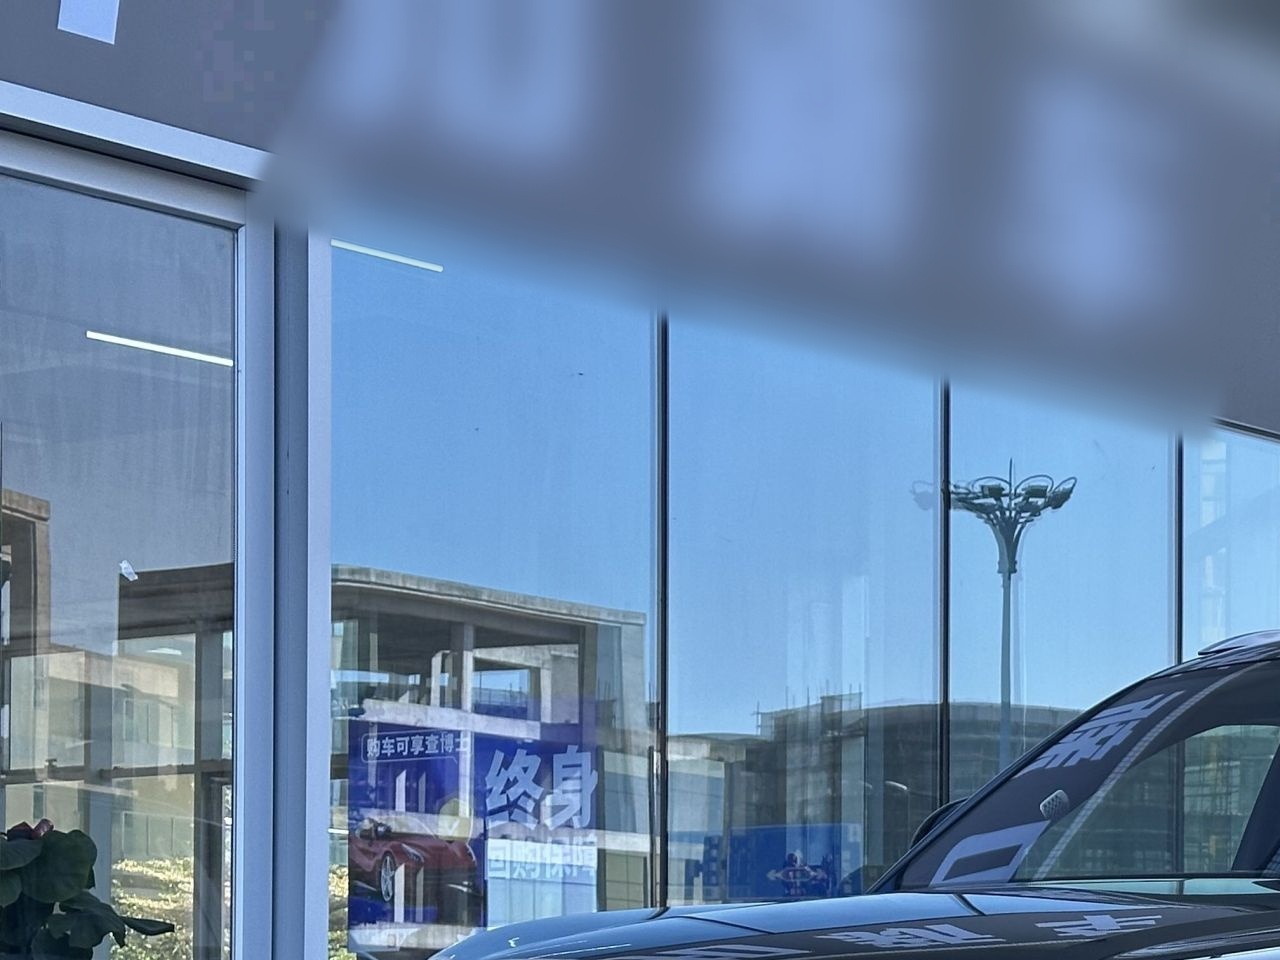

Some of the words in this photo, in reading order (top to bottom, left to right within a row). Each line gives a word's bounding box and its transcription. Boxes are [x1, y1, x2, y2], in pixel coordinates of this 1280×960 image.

[366, 733, 470, 758] 购车可享查博士
[485, 744, 599, 831] 终身
